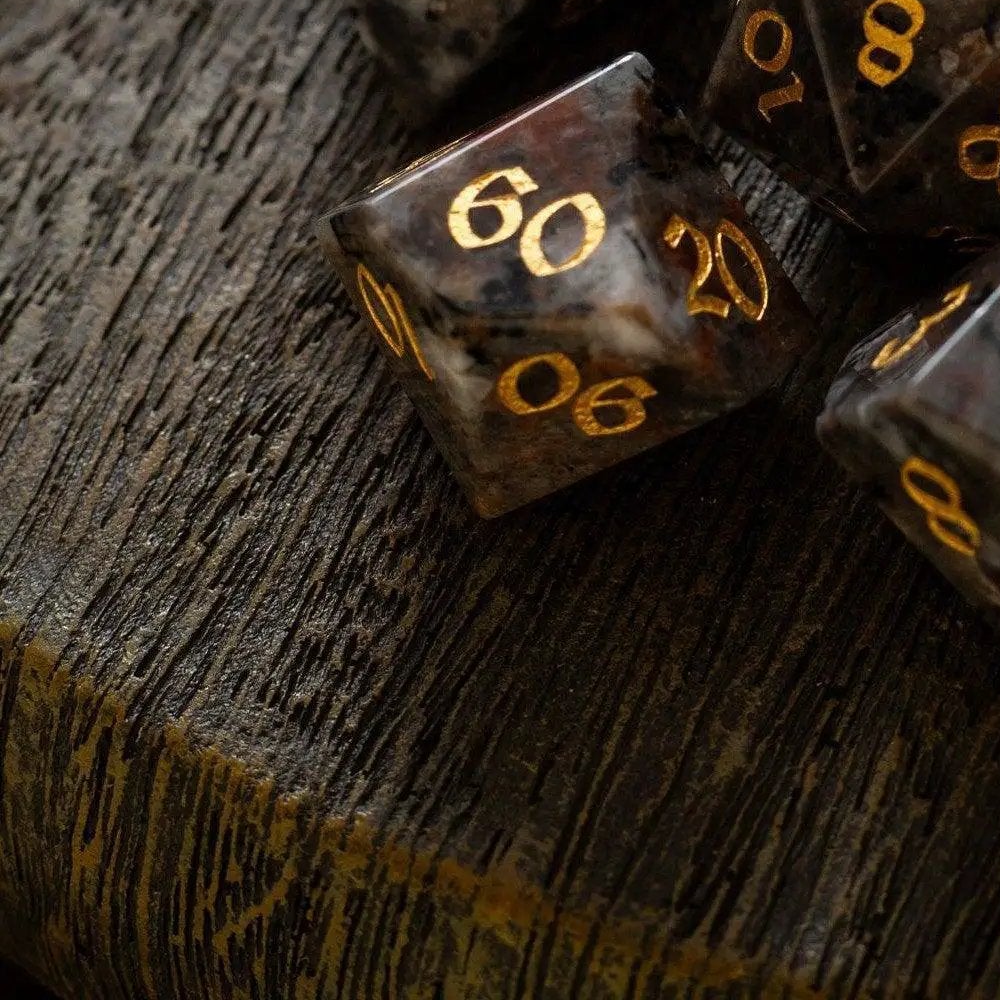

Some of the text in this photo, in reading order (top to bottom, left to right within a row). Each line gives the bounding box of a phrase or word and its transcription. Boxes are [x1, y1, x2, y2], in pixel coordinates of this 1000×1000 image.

[447, 166, 606, 277] 60
[662, 214, 769, 322] 20
[901, 456, 981, 558] 8
